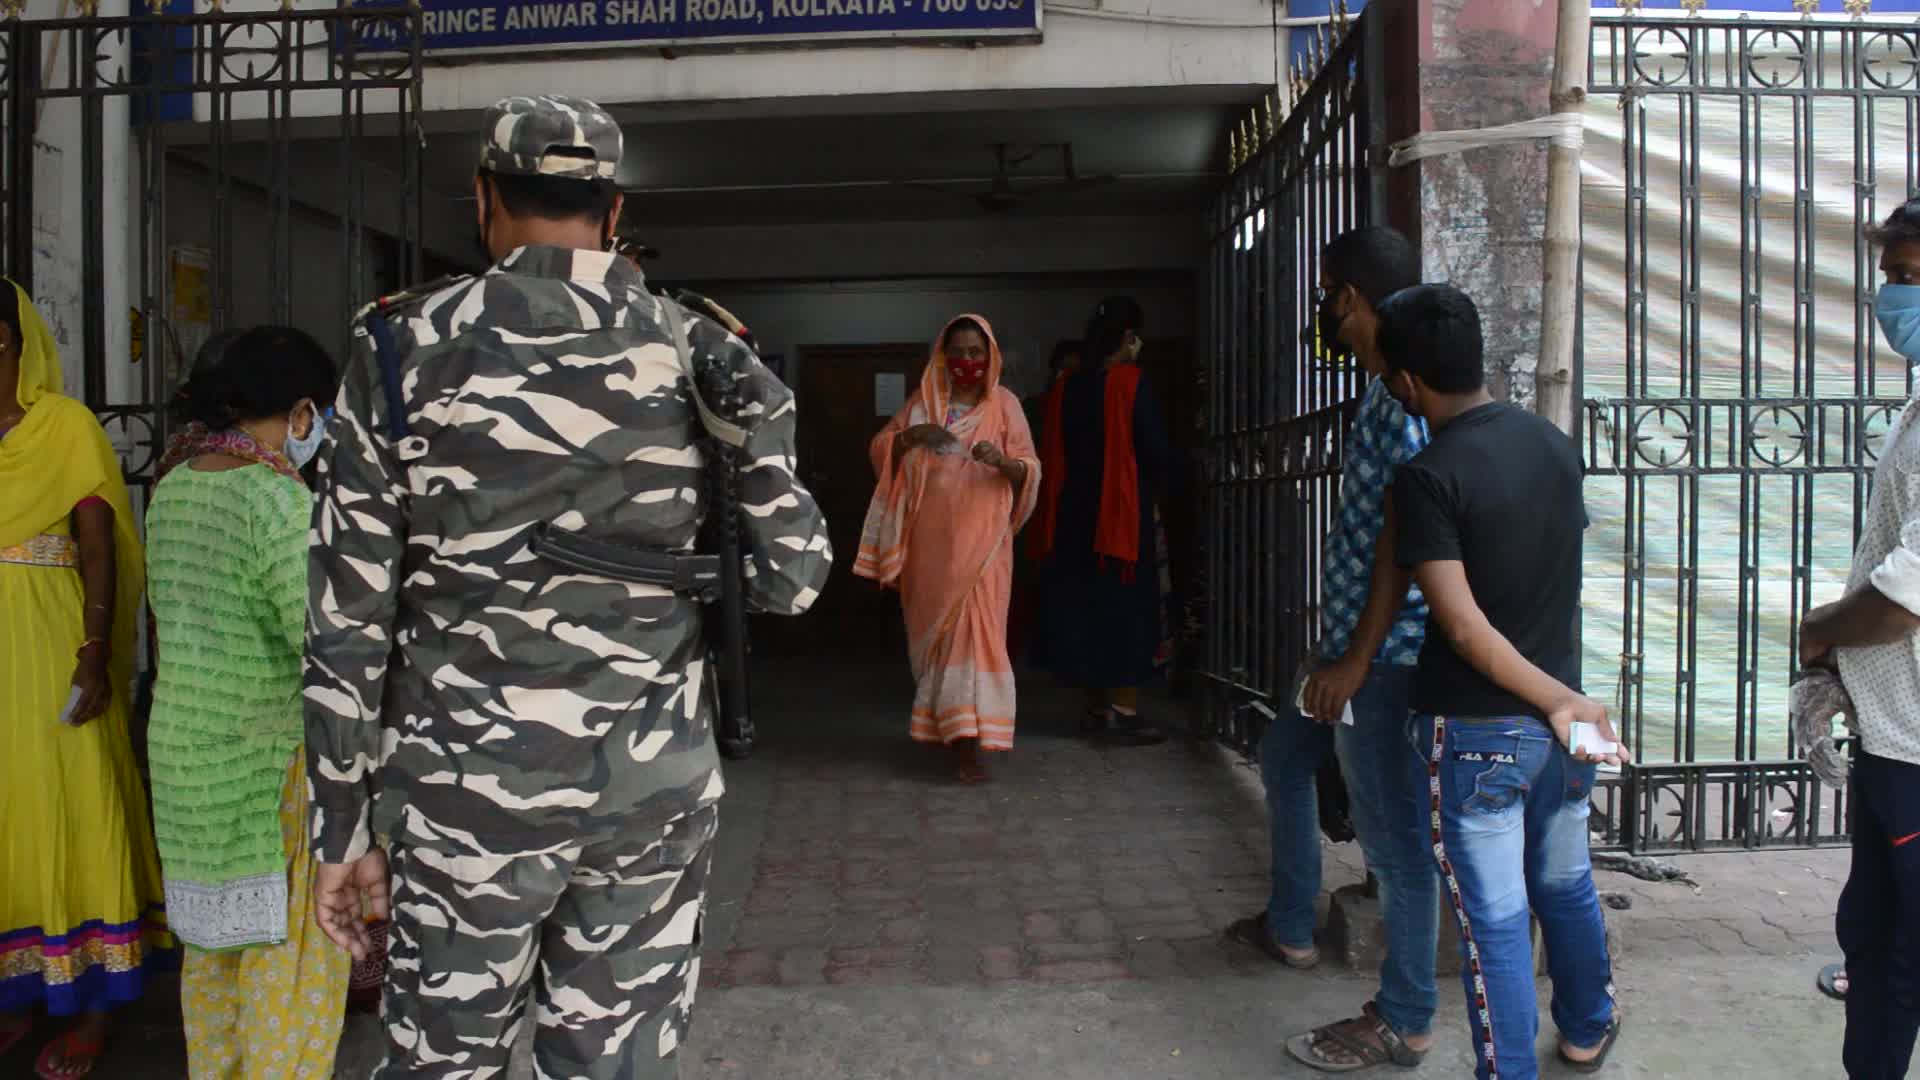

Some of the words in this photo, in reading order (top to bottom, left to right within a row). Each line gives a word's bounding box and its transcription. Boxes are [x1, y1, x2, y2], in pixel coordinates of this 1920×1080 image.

[504, 3, 597, 31] ANWAR
[605, 0, 676, 25] SHAH
[685, 0, 763, 24] ROAD,
[772, 0, 896, 18] KOLKATA
